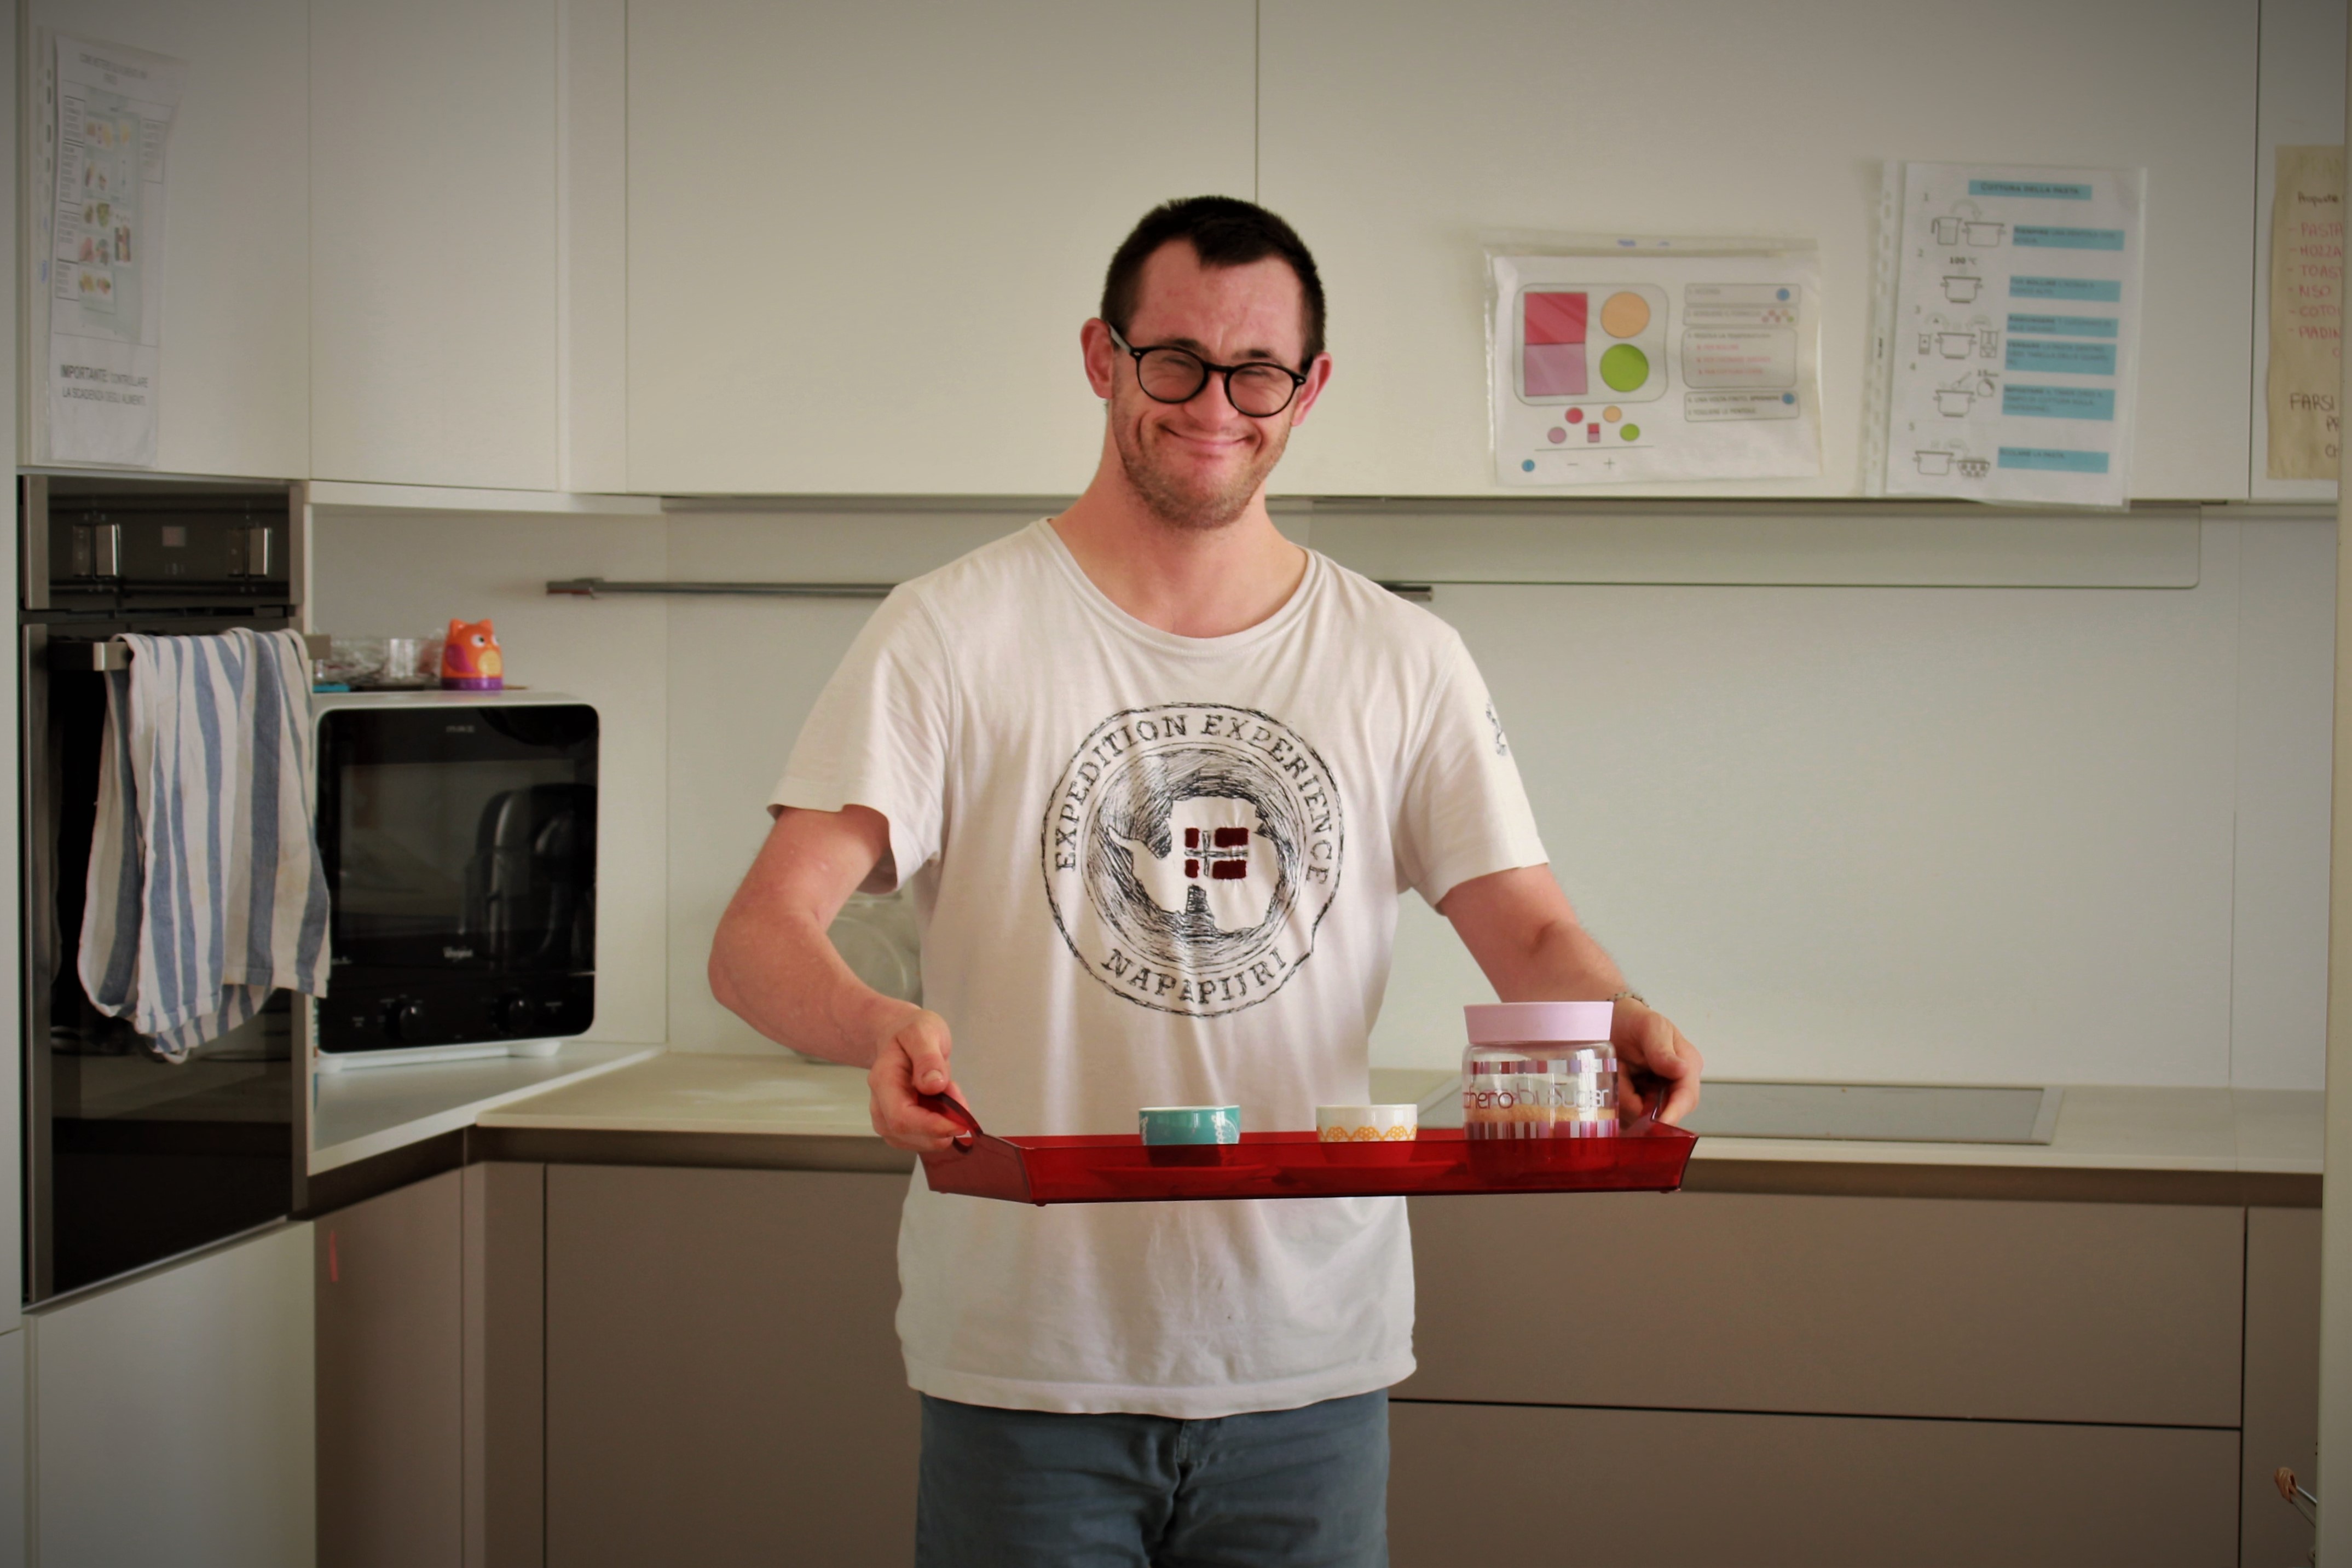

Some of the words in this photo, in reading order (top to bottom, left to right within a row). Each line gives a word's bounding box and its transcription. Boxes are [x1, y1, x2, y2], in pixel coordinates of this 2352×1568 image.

[2301, 222, 2343, 238] PASTA
[2290, 392, 2334, 412] FARSI
[1056, 714, 1187, 871] EXPEDITION
[1201, 714, 1332, 885] EXPERIENCE
[1101, 946, 1288, 1004] NAPAPIJRI
